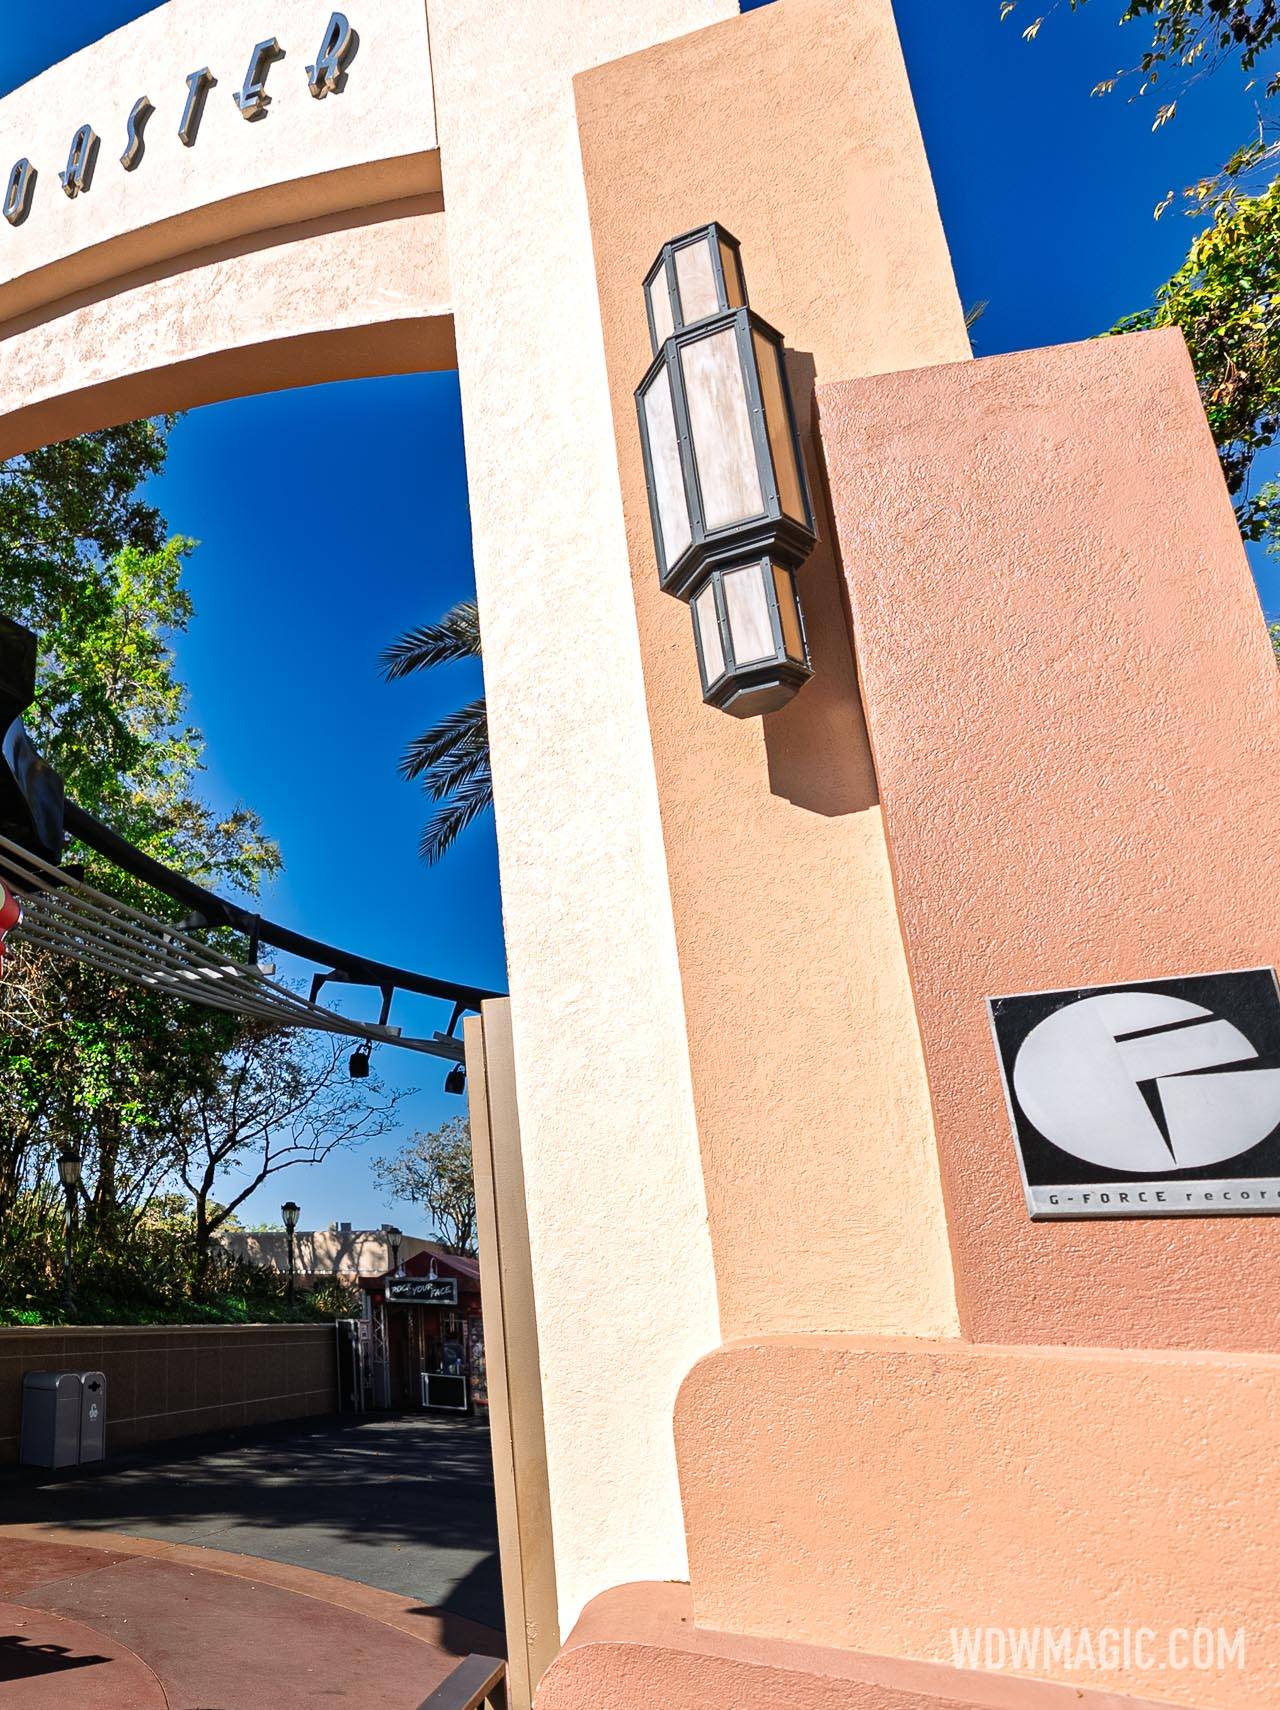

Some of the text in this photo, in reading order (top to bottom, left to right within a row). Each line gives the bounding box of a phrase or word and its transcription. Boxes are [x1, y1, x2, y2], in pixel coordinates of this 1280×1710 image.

[1049, 1190, 1280, 1205] G-FORCE recor
[391, 1283, 452, 1298] ROCK YOUR FACE
